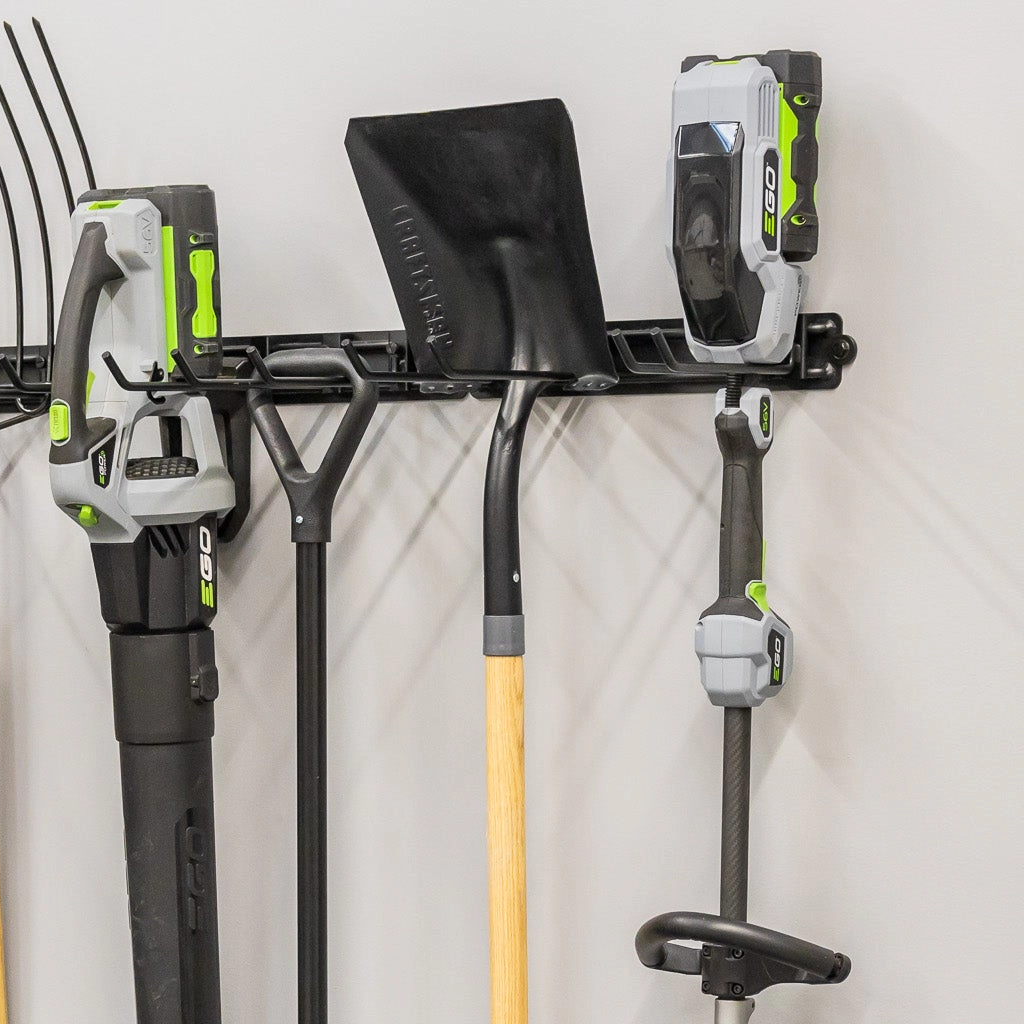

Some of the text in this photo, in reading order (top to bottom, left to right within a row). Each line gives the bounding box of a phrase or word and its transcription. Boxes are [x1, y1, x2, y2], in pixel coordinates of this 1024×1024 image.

[765, 165, 776, 237] EGO
[199, 526, 214, 608] EGO
[773, 637, 781, 682] EGO
